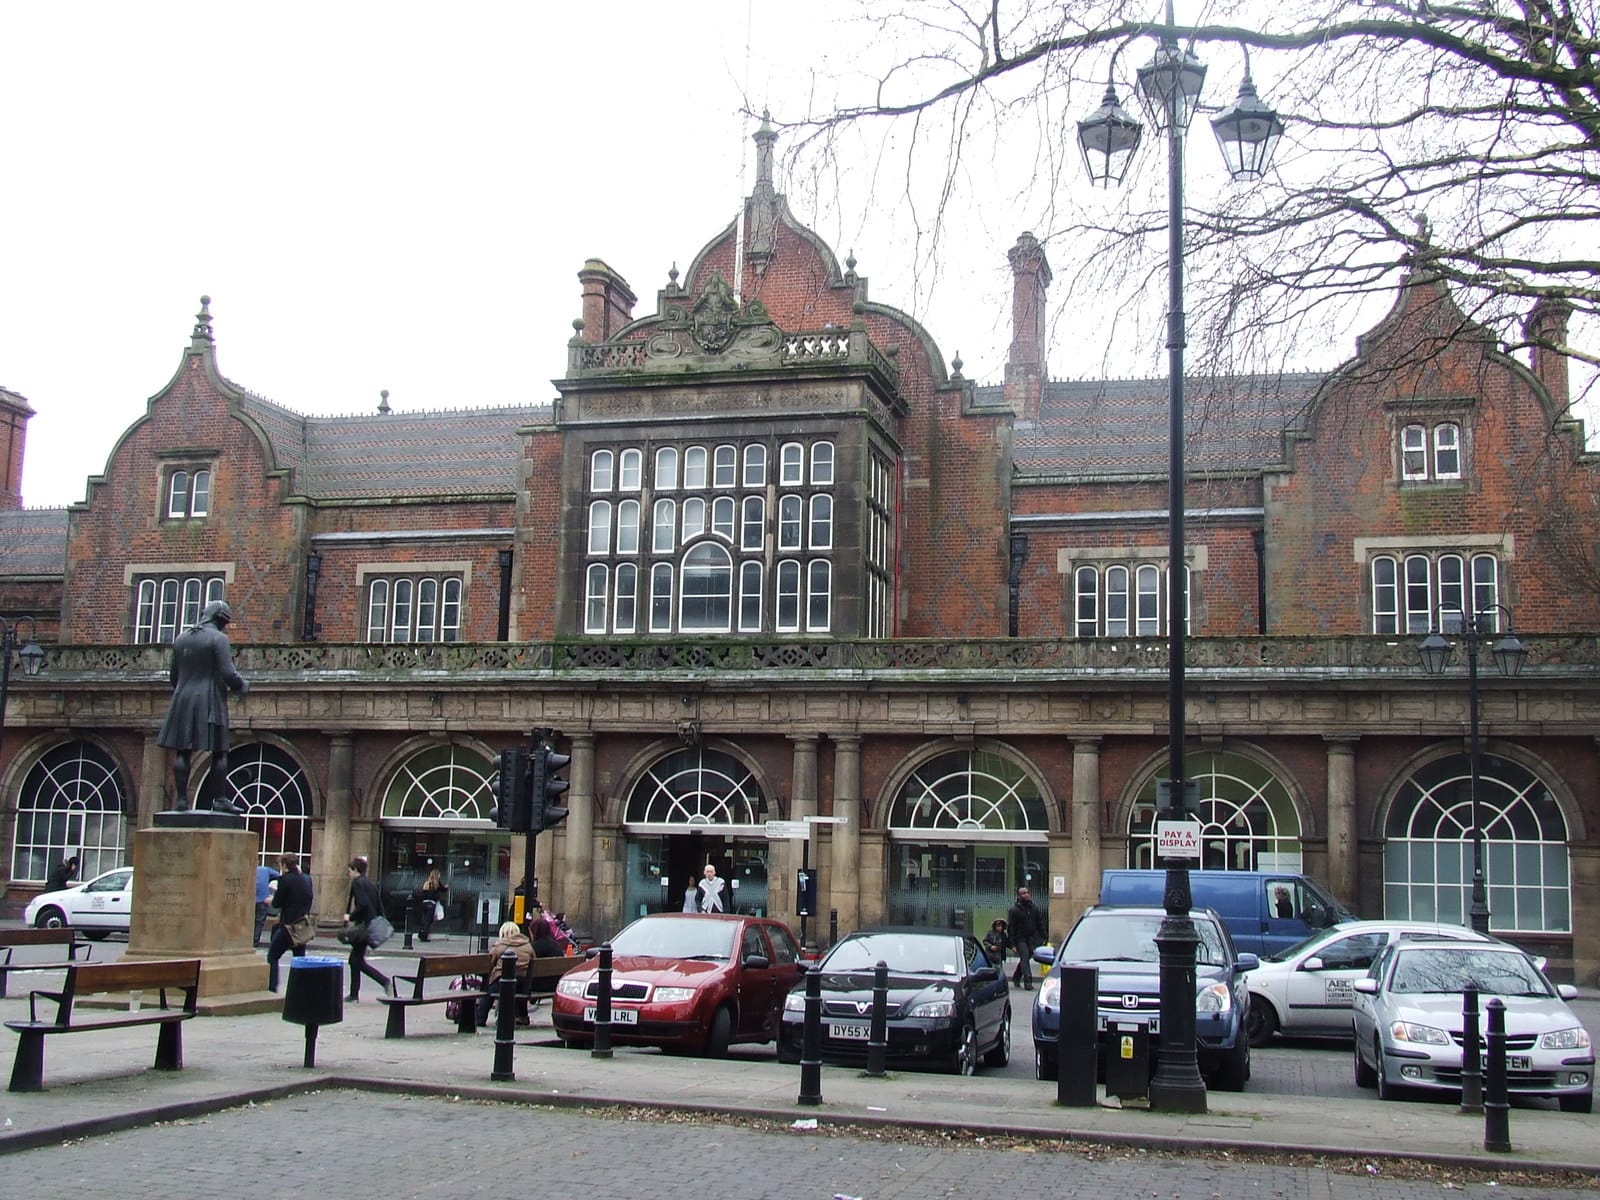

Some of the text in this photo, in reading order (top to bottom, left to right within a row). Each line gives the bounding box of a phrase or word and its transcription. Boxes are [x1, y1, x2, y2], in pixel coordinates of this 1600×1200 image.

[1185, 831, 1192, 839] &
[1159, 839, 1197, 847] DISPLAY
[614, 1011, 633, 1022] LRL
[834, 1025, 860, 1037] DY55
